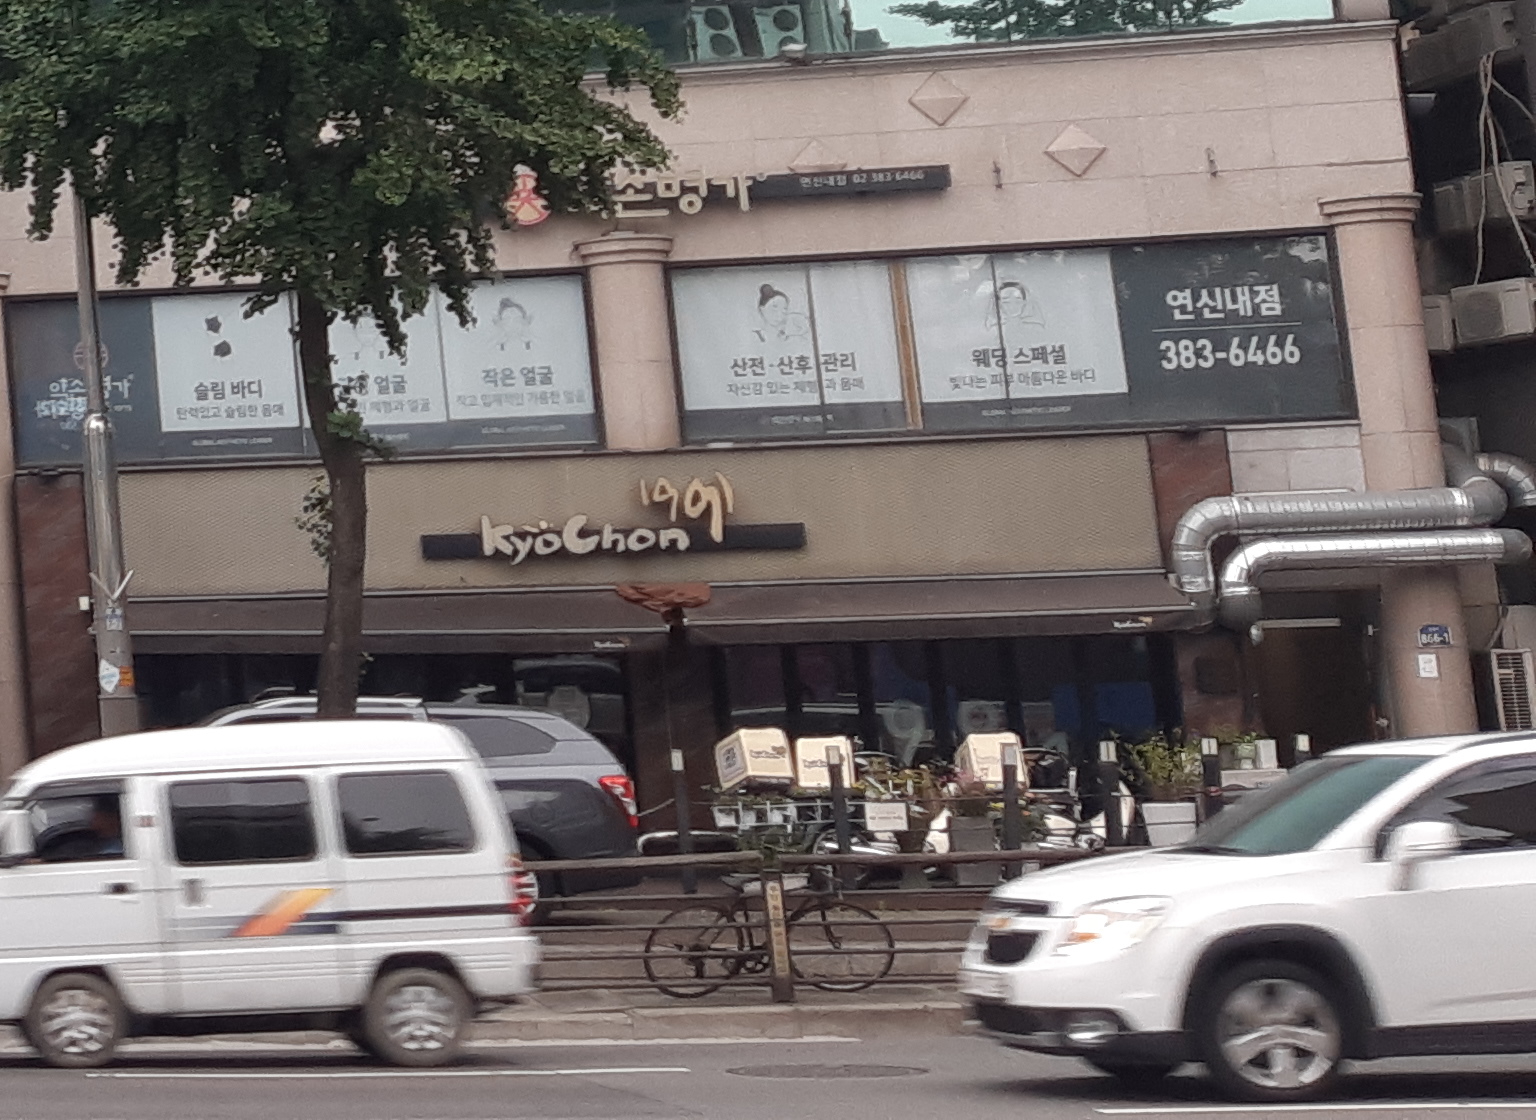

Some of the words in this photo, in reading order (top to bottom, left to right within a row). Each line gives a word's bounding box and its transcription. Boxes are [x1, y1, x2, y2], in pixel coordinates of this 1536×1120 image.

[611, 165, 754, 219] 손명가
[1165, 283, 1283, 320] 연신내점
[821, 352, 857, 373] 관리
[1013, 344, 1068, 365] 스페셜
[1159, 334, 1302, 371] 383-6466
[482, 366, 516, 388] 작은
[519, 365, 554, 387] 얼굴
[193, 381, 226, 401] 슬림
[231, 379, 264, 399] 바디
